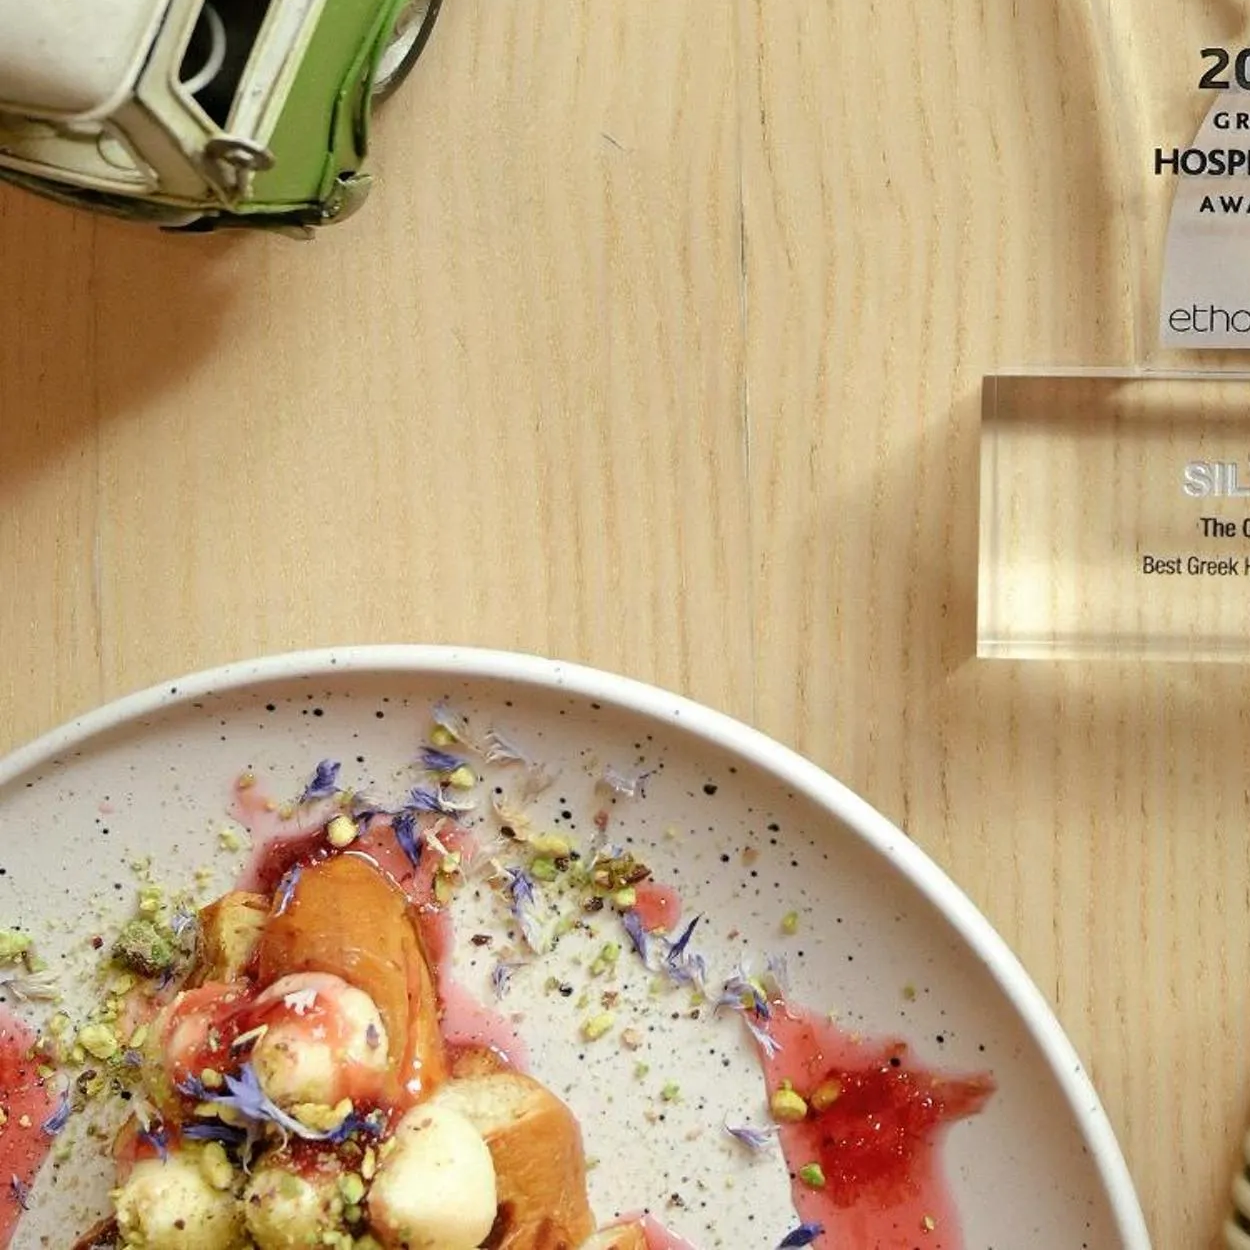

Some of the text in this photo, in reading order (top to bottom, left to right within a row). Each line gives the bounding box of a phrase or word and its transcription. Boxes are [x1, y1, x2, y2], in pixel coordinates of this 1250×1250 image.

[1200, 517, 1236, 537] The
[1142, 556, 1182, 574] Best
[1187, 556, 1239, 575] Greek
